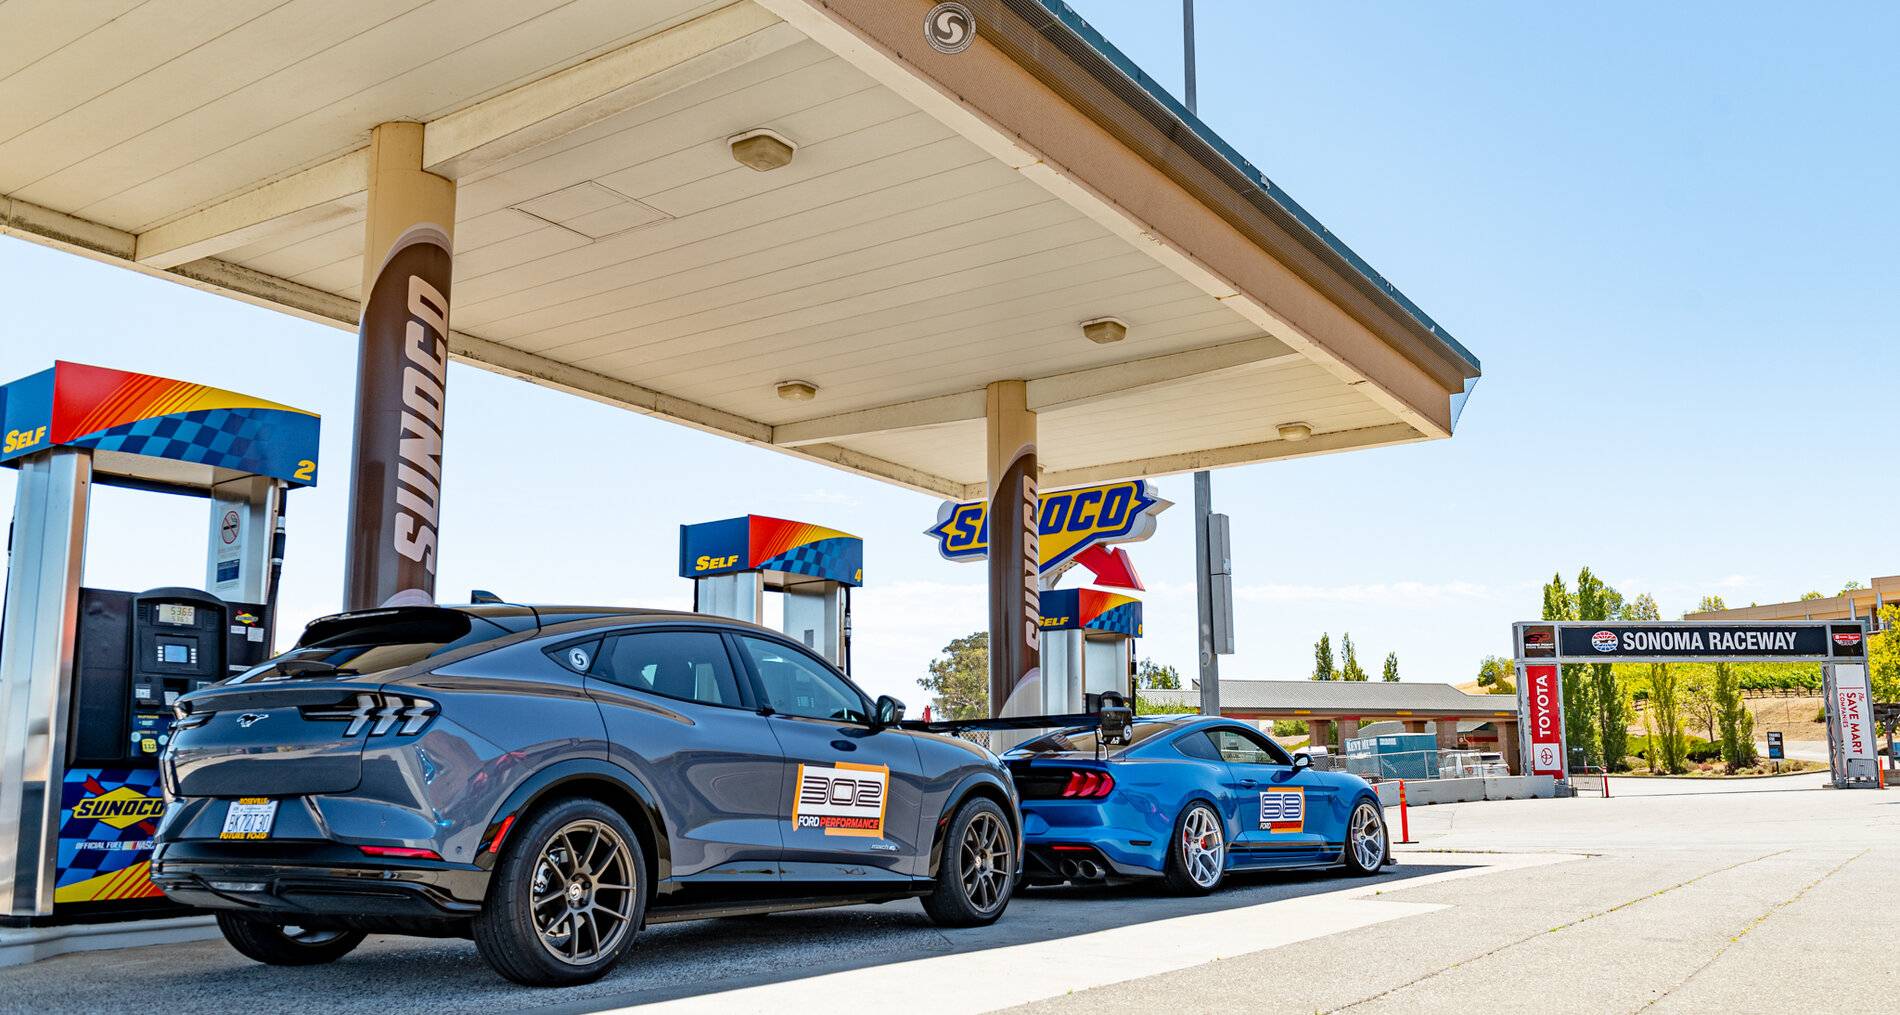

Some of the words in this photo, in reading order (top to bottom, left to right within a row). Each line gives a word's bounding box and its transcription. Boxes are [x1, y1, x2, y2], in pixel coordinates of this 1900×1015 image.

[394, 274, 449, 575] SUNOCO
[3, 425, 47, 453] SELF
[294, 460, 316, 481] 2
[950, 486, 1133, 547] SOCO
[696, 555, 738, 570] SELF
[854, 568, 862, 582] 4
[1623, 631, 1703, 651] SONOMA
[1709, 631, 1797, 651] RACEWAY
[1540, 674, 1551, 738] TOYOTA
[1839, 692, 1848, 728] COMPANIES
[1846, 692, 1860, 720] SAVE
[1850, 722, 1862, 755] MART
[800, 776, 882, 808] 302
[77, 800, 165, 816] SUNOCO
[1262, 794, 1302, 819] 68
[798, 816, 820, 826] FORD
[820, 818, 879, 829] PERFORMANCE
